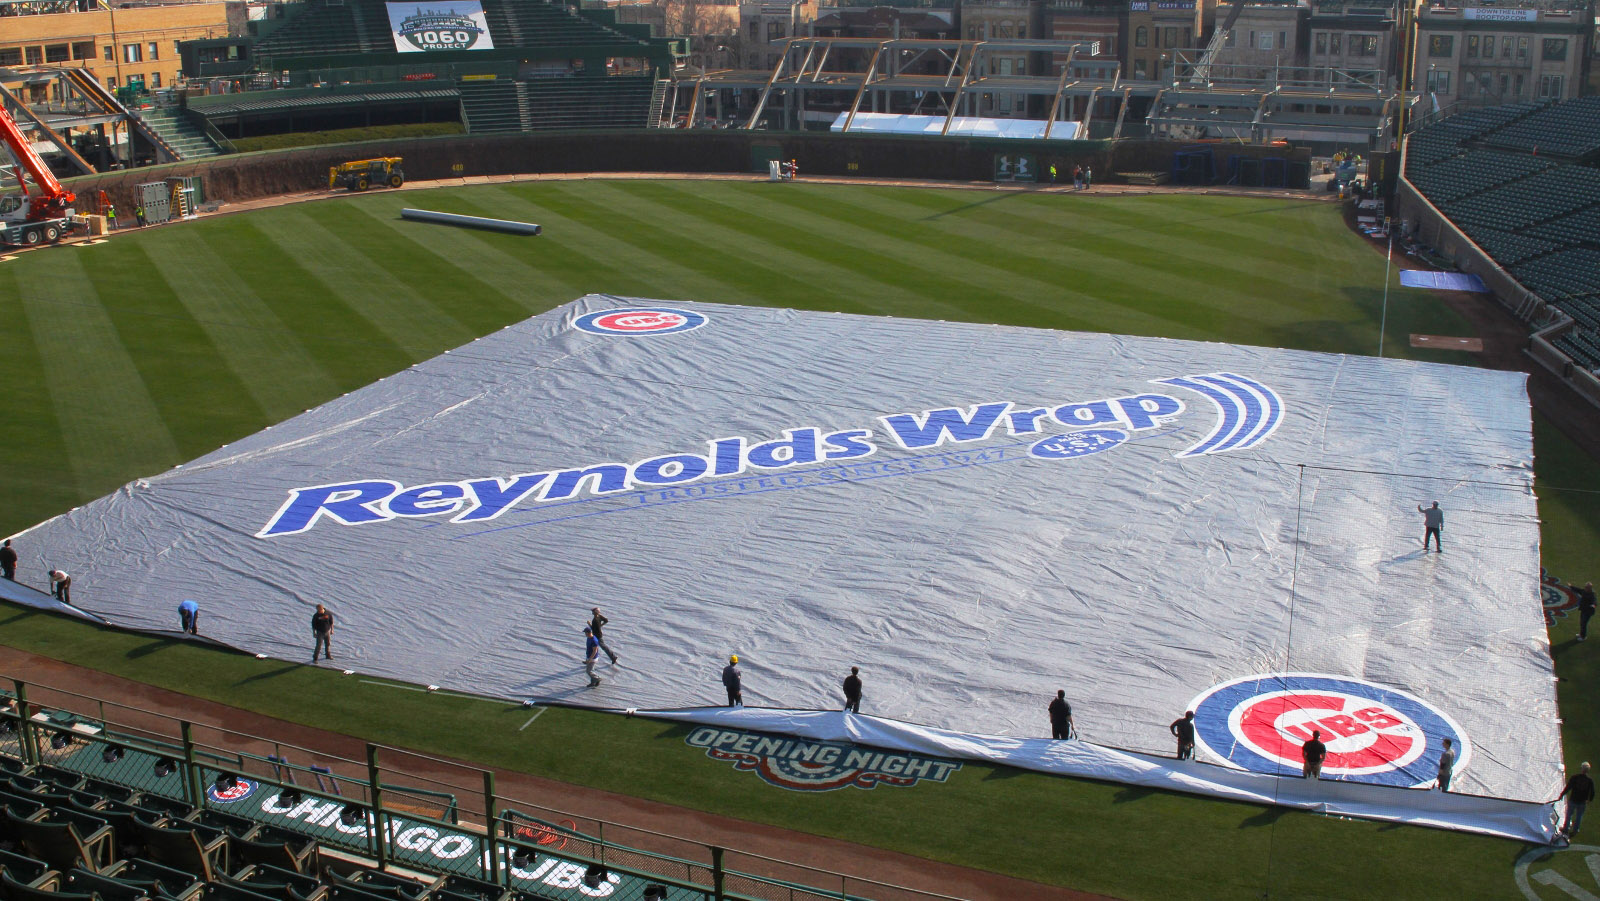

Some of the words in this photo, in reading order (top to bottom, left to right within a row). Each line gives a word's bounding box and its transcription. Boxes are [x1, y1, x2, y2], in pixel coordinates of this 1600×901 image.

[413, 31, 470, 44] 1060
[255, 427, 878, 538] Reynolds
[876, 393, 1186, 450] Wrap
[1042, 434, 1124, 452] U.S.A.
[629, 474, 804, 504] TRUSTED
[939, 449, 1005, 467] 1947
[689, 729, 843, 764] OPENING
[846, 750, 958, 781] NIGHT
[1240, 694, 1413, 770] CUBS
